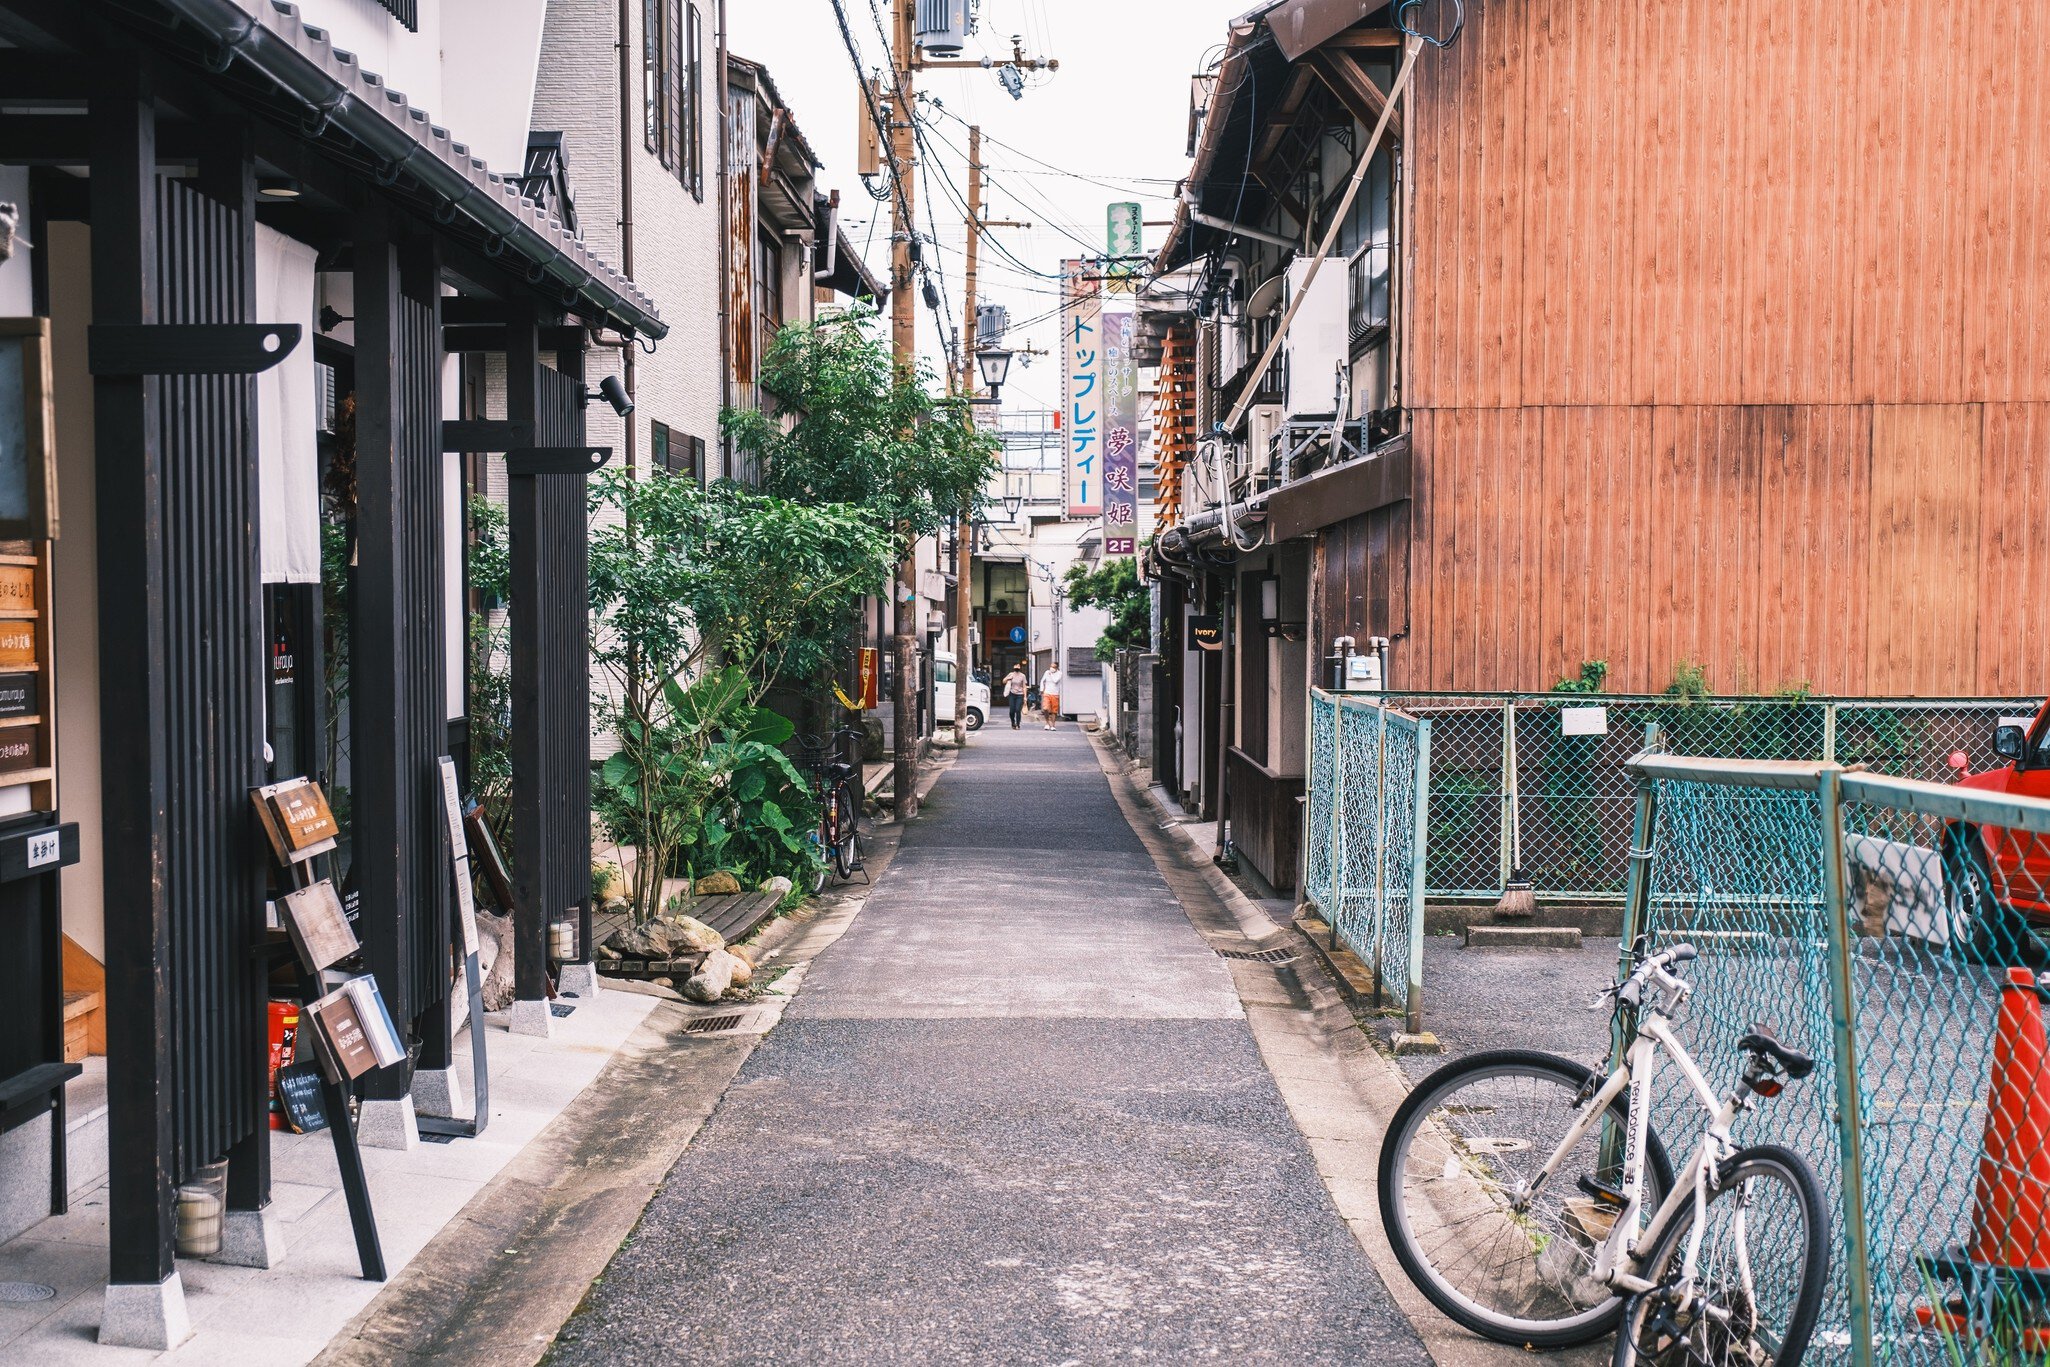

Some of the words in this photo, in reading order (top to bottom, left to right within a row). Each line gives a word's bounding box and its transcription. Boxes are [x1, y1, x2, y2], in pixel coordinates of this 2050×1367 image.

[1072, 315, 1097, 504] トップレディー
[1107, 428, 1133, 526] 夢咲姫
[1109, 540, 1131, 552] 2F
[1195, 628, 1217, 638] Ivory
[1631, 1080, 1641, 1104] new
[1627, 1107, 1639, 1161] balance
